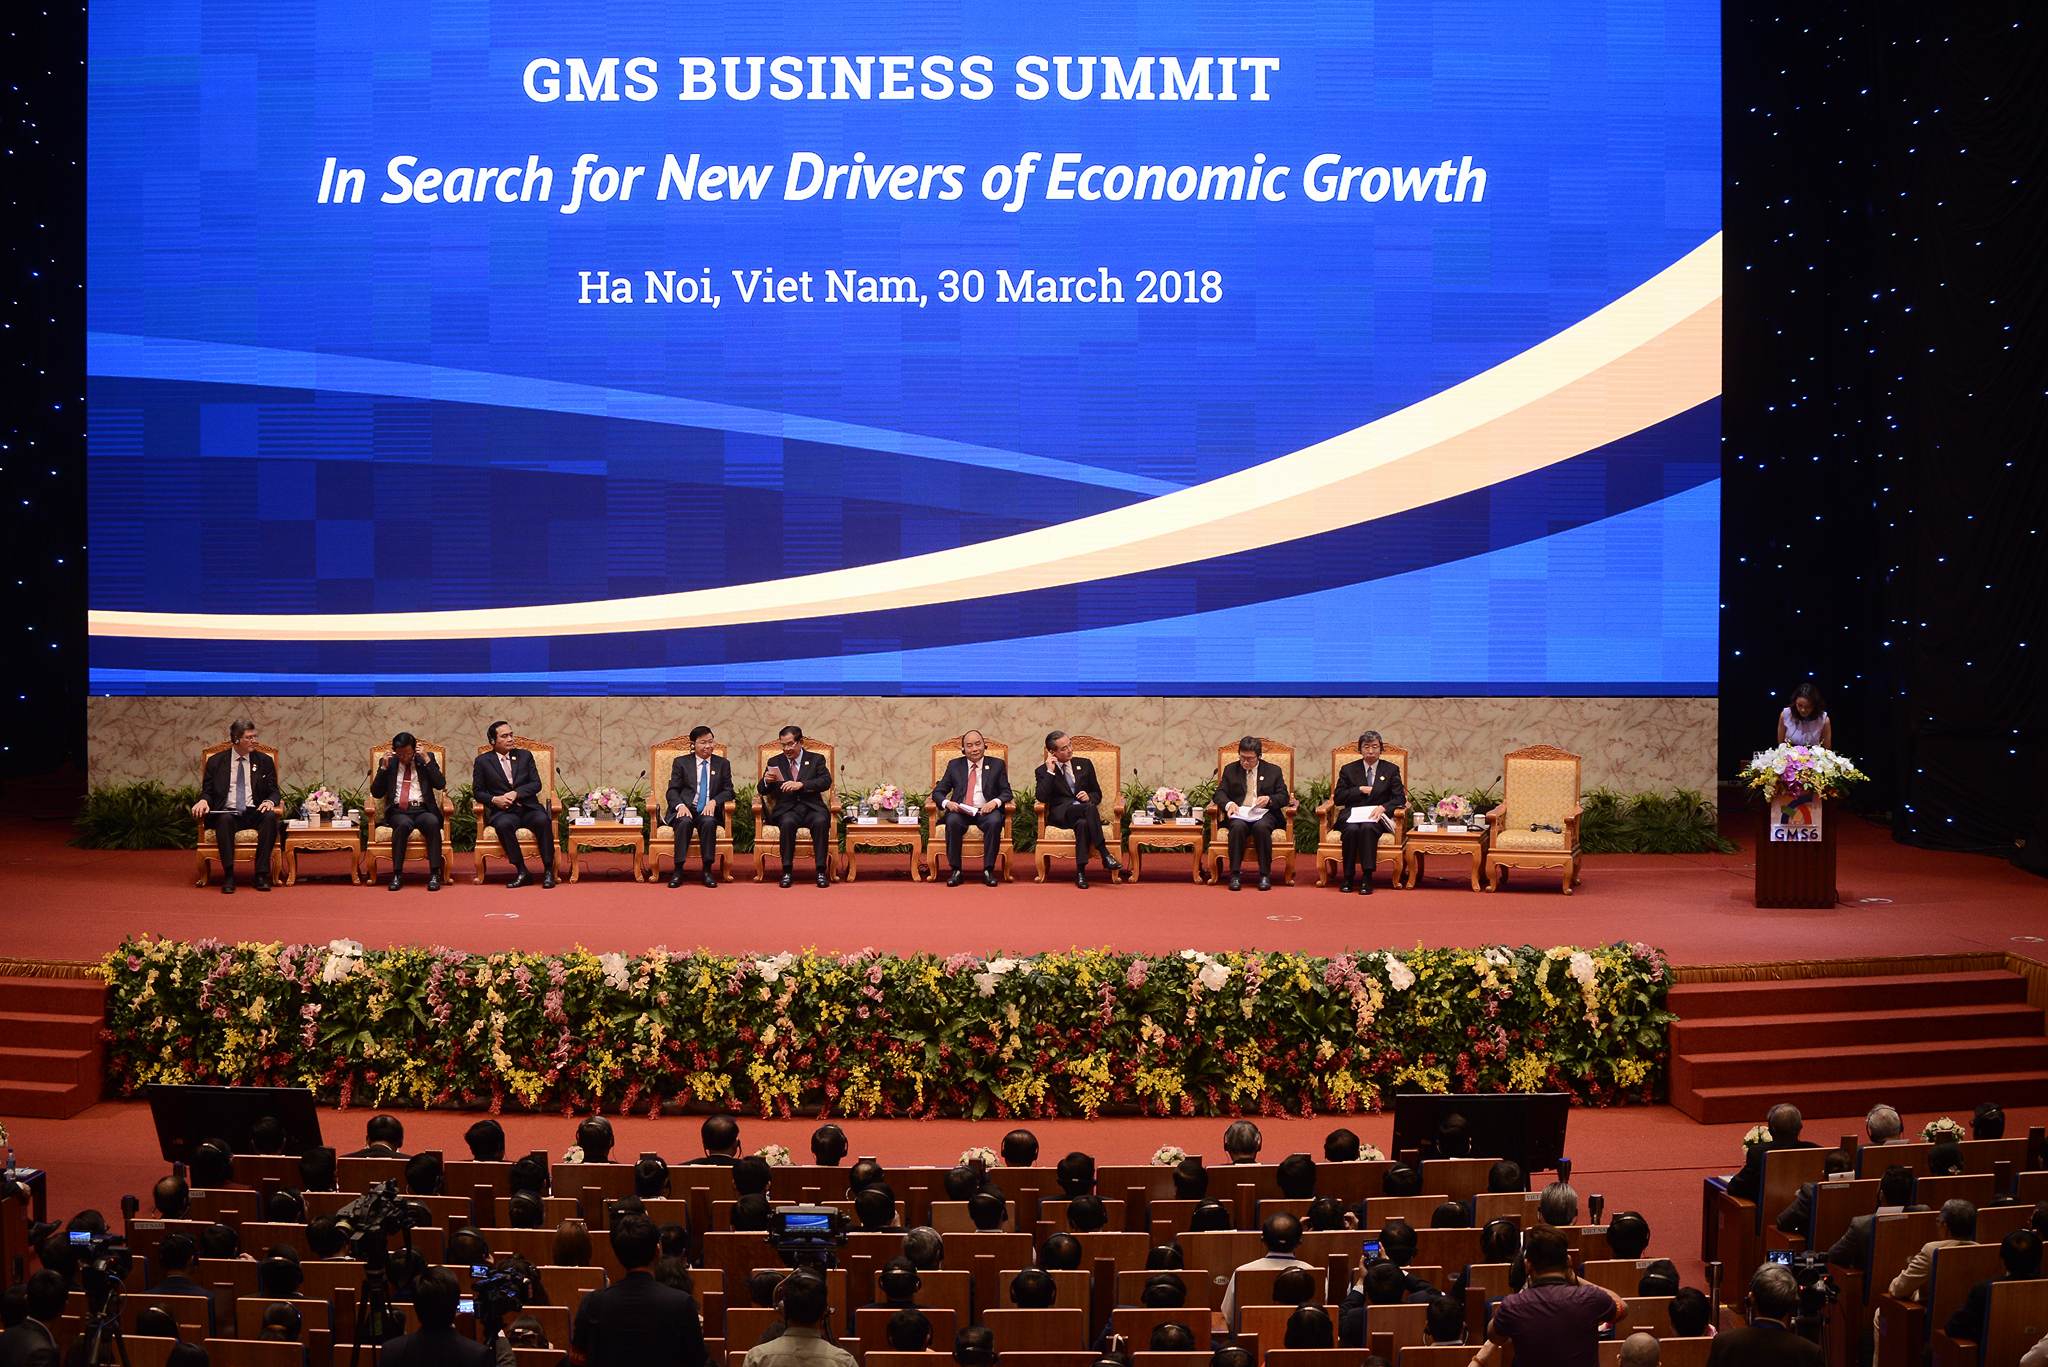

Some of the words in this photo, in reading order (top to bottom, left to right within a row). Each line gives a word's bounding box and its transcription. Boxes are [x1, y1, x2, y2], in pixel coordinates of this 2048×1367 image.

[523, 56, 658, 102] GMS
[679, 56, 993, 101] BUSINESS
[1016, 56, 1279, 101] SUMMIT
[318, 158, 365, 203] In
[381, 154, 553, 203] Search
[560, 154, 645, 214] for
[657, 154, 774, 201] New
[784, 152, 965, 201] Drivers
[982, 152, 1042, 212] of
[1046, 153, 1290, 201] Economic
[1303, 154, 1486, 202] Growth
[579, 270, 633, 303] Ha
[645, 268, 720, 308] Noi,
[732, 268, 813, 303] Viet
[825, 270, 927, 308] Nam,
[939, 270, 984, 303] 30
[996, 267, 1124, 303] March
[1136, 270, 1222, 303] 2018
[1774, 828, 1818, 840] GMS6
